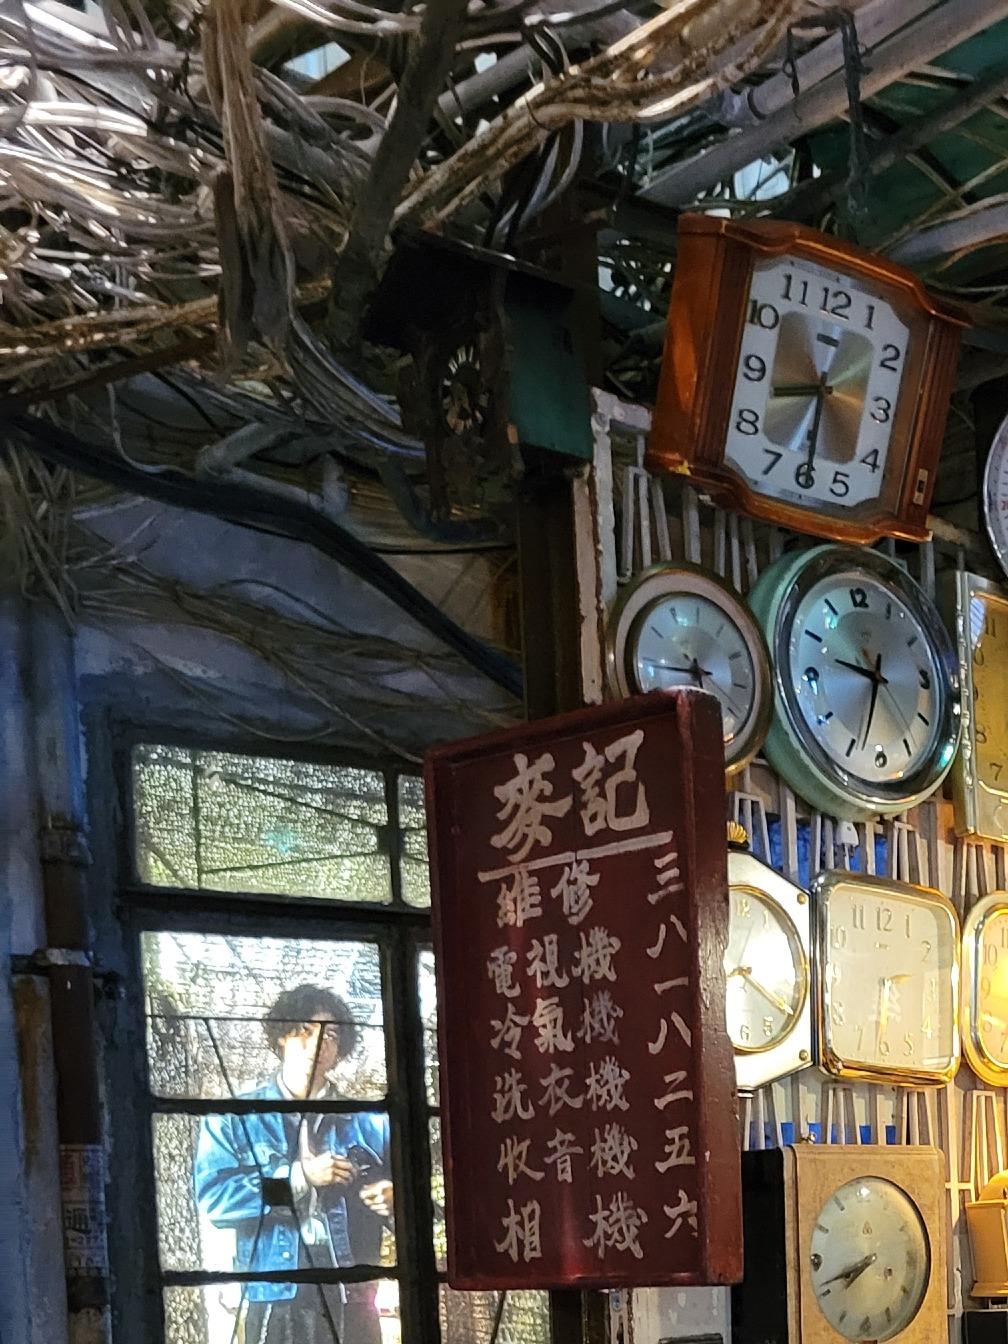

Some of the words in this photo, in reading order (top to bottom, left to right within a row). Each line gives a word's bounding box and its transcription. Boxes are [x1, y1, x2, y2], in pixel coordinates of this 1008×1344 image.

[781, 272, 809, 307] 11
[749, 299, 779, 330] 10
[819, 287, 852, 321] 12
[864, 304, 875, 331] 1
[742, 353, 767, 382] 9
[878, 343, 900, 373] 2
[735, 408, 760, 435] 8
[870, 396, 891, 424] 3
[762, 448, 783, 476] 7
[860, 448, 881, 474] 4
[795, 462, 815, 490] 6
[829, 470, 850, 497] 5
[849, 588, 869, 609] 12
[975, 724, 987, 744] 8
[989, 763, 1003, 782] 7
[497, 860, 600, 928] 維修
[852, 904, 865, 930] 11
[876, 907, 893, 931] 12
[905, 914, 911, 939] 1
[487, 926, 622, 998] 電視機
[920, 940, 931, 964] 2
[983, 944, 998, 966] 10
[490, 989, 625, 1060] 冷氣機
[903, 1031, 914, 1056] 5
[491, 1055, 631, 1123] 洗衣機
[497, 1122, 639, 1185] 收音機
